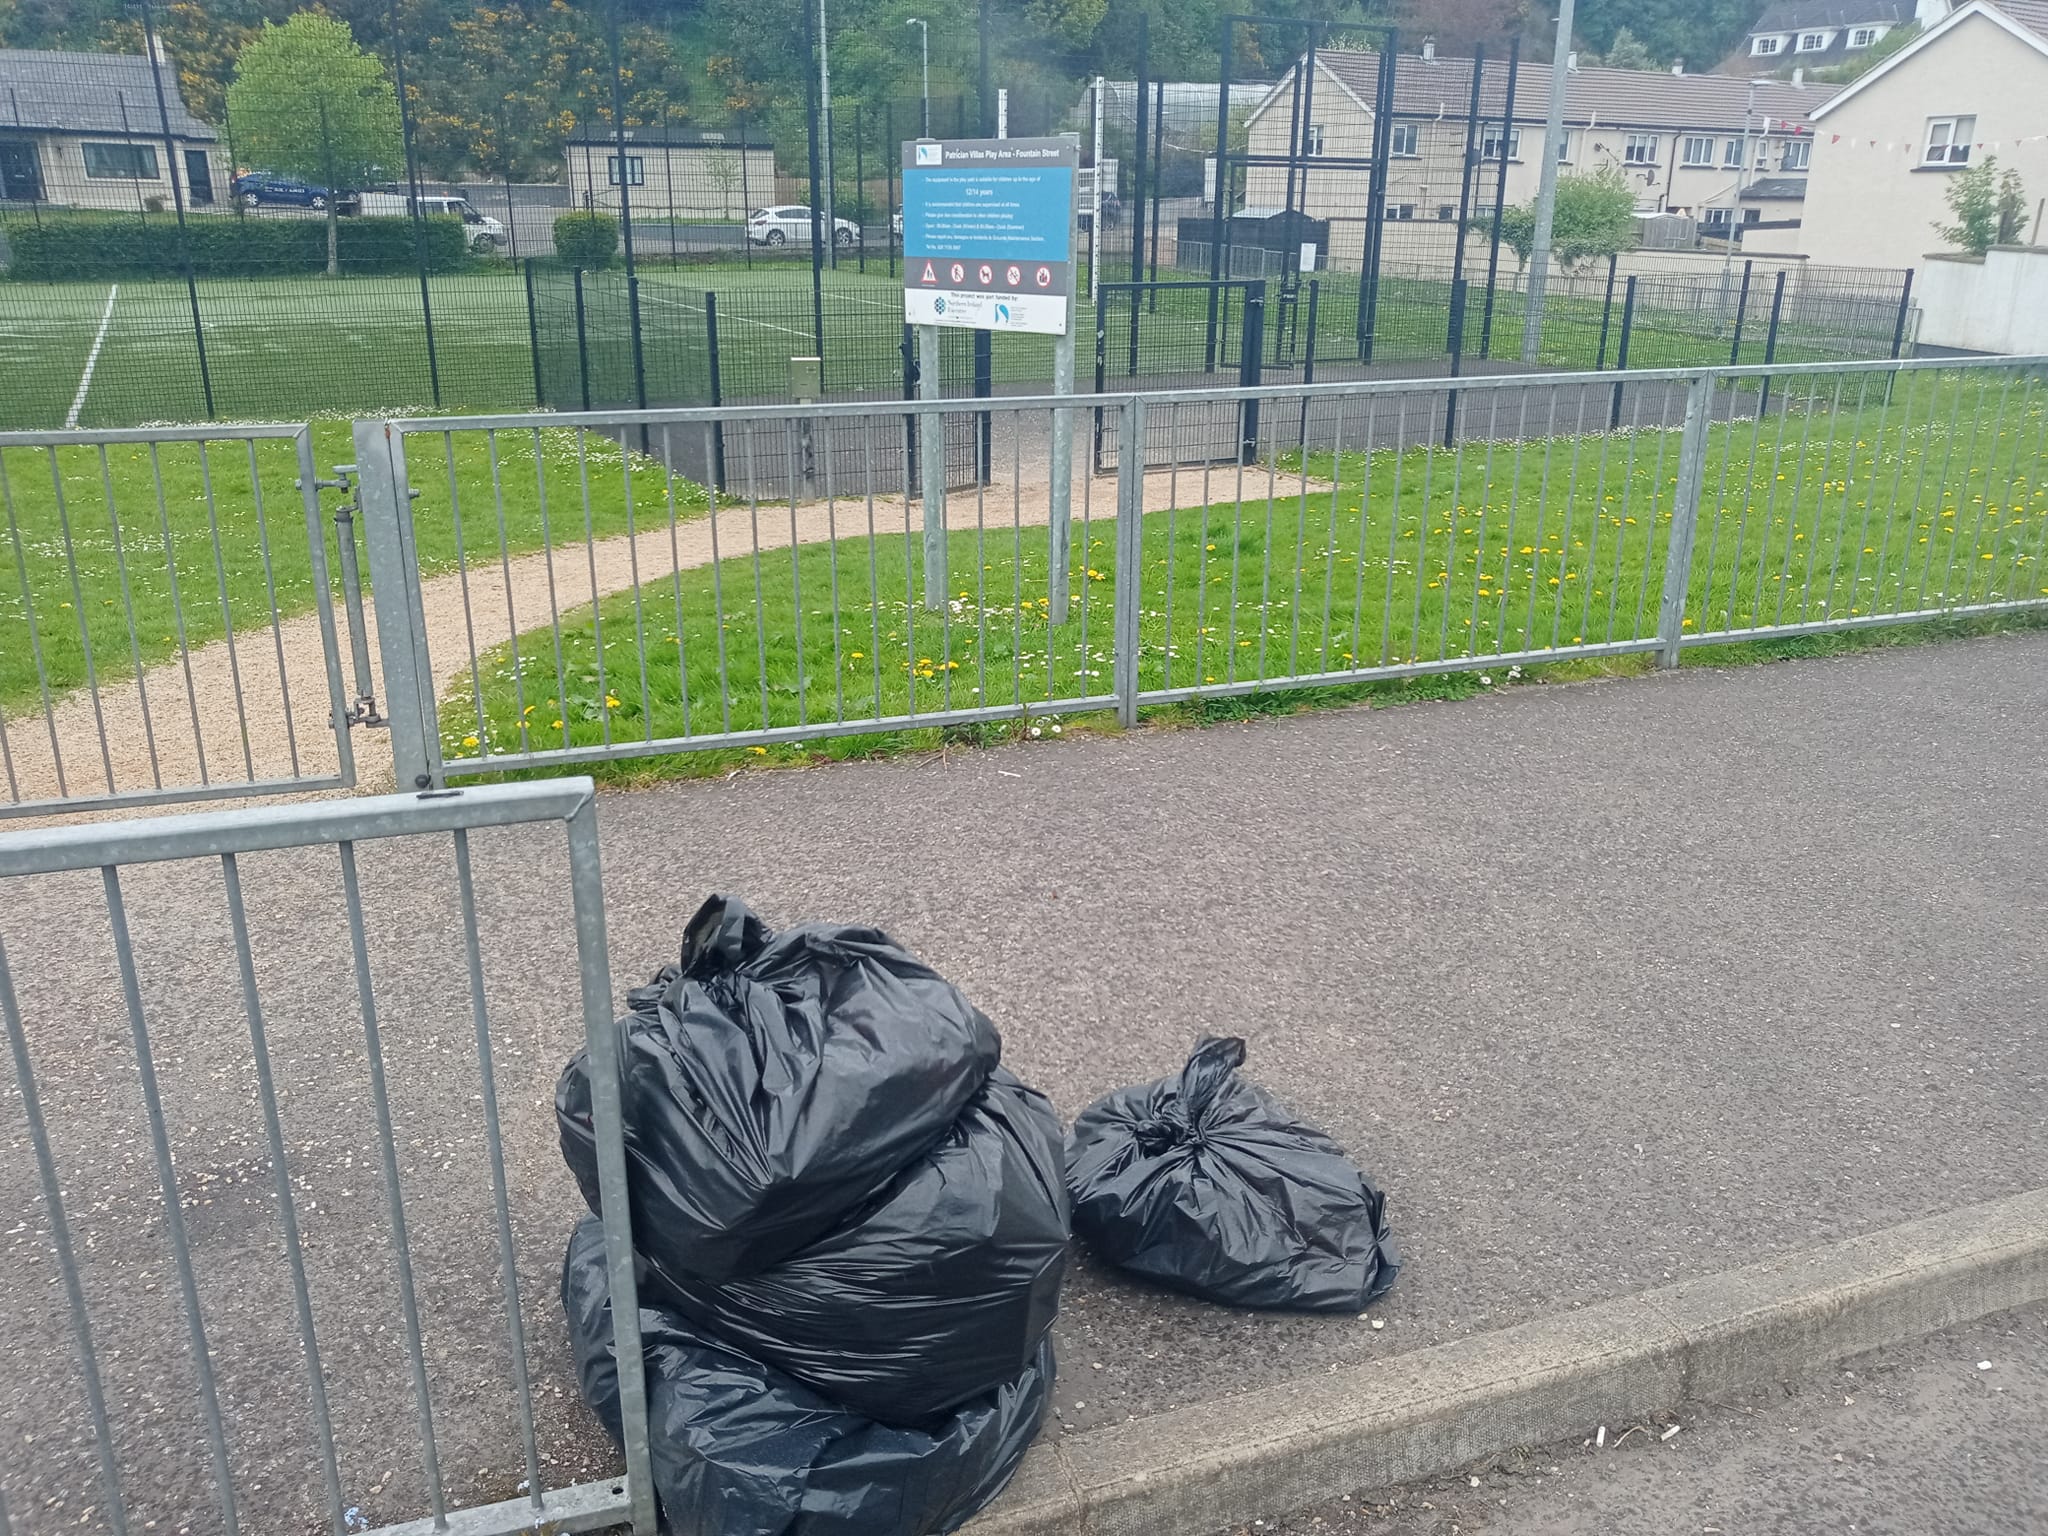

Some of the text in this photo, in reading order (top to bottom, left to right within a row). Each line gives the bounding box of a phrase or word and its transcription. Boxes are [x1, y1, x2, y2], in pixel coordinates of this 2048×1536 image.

[945, 150, 968, 160] Patrician
[970, 150, 984, 158] Villas
[986, 150, 997, 160] Play
[998, 150, 1011, 158] Area
[1016, 149, 1040, 158] Fountain
[1042, 148, 1059, 158] Street
